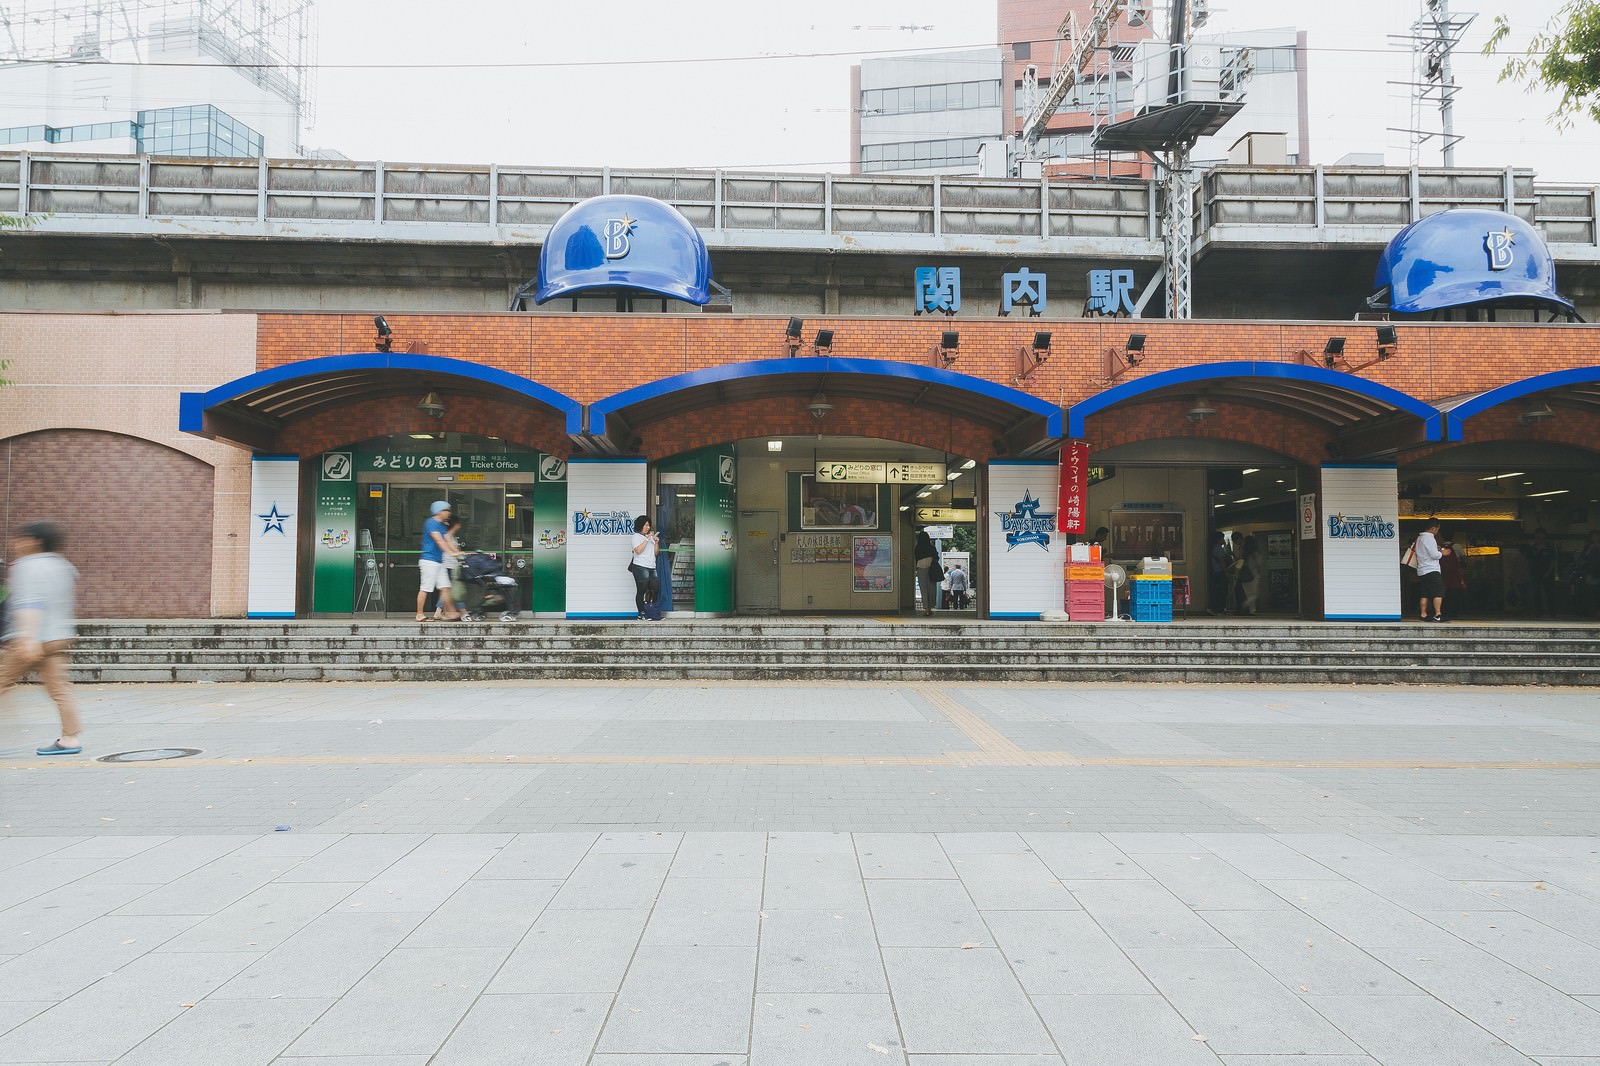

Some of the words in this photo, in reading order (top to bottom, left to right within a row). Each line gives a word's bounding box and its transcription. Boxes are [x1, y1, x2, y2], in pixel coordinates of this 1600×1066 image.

[603, 218, 630, 259] B
[1486, 231, 1513, 270] B
[914, 266, 1136, 315] 関内駅
[373, 455, 462, 469] みどりの窓口
[470, 461, 494, 469] Ticket
[496, 461, 519, 469] Office
[1066, 446, 1080, 530] シウマイの崎陽軒
[573, 510, 638, 535] BAYSTAR
[1001, 512, 1056, 532] BAYSTARS
[1328, 514, 1396, 539] BAYSTARS
